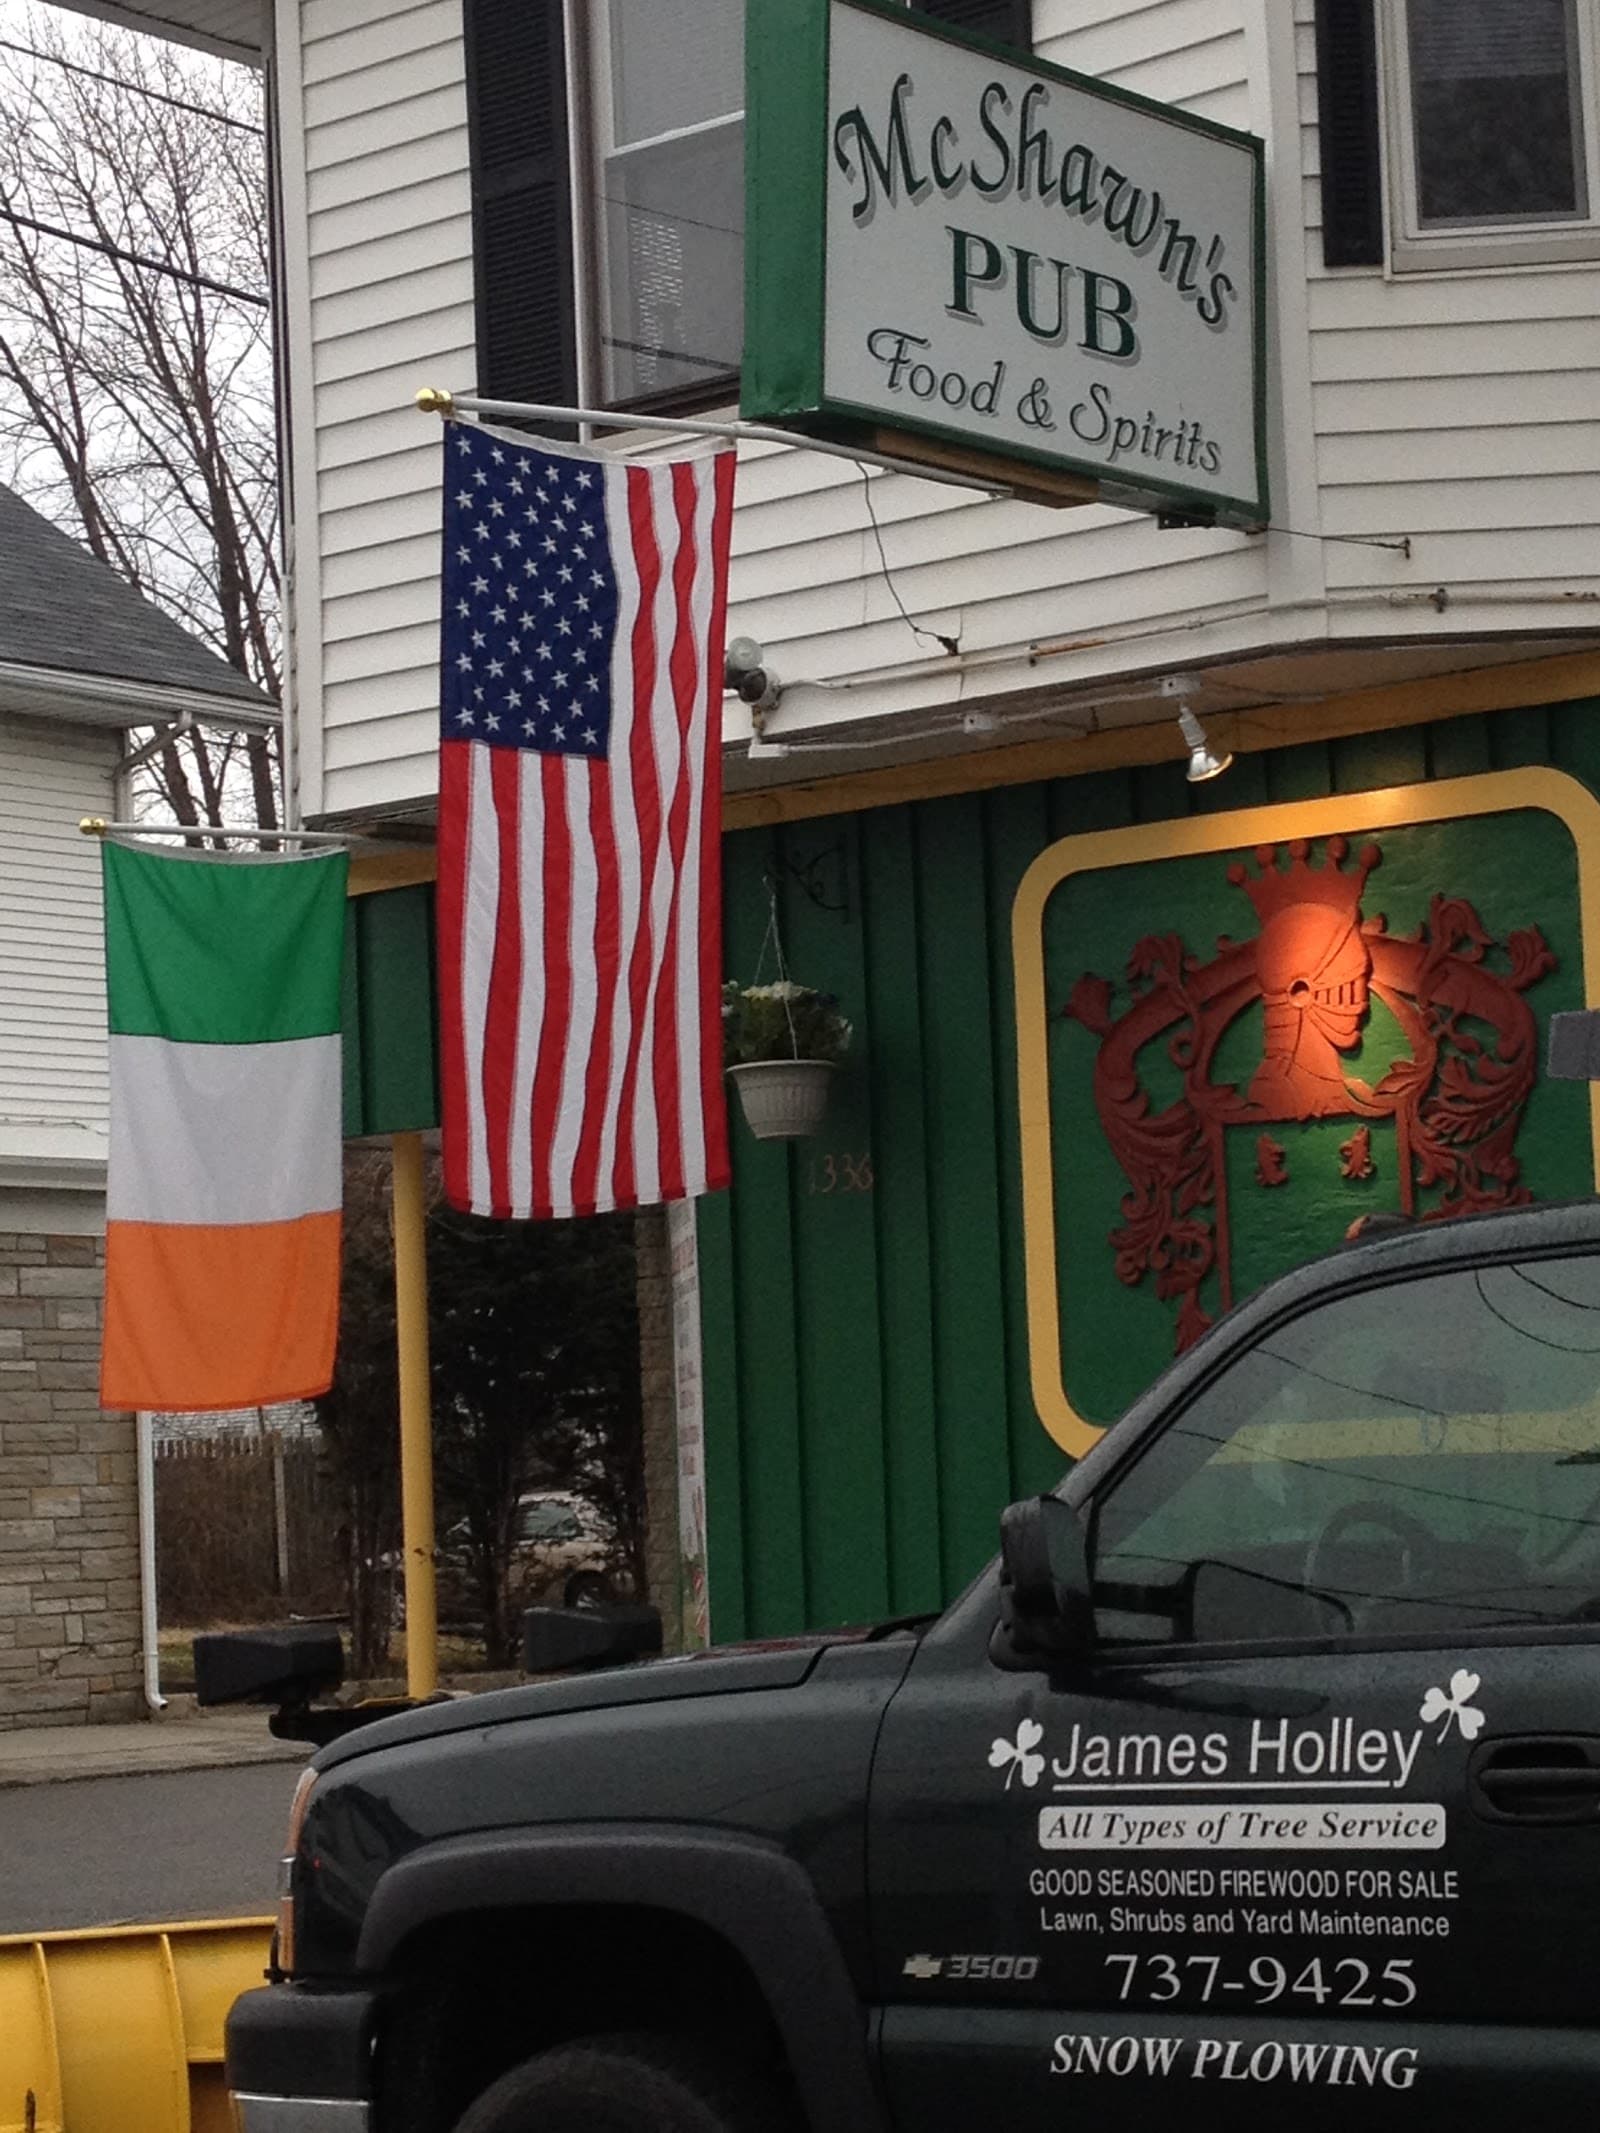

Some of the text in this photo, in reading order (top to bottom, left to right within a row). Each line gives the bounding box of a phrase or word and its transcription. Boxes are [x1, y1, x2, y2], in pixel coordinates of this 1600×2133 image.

[833, 72, 1238, 326] McShawn's
[944, 224, 1140, 365] PUB
[866, 327, 1222, 474] Food & Spirits
[1052, 1717, 1424, 1788] James Holley
[1047, 1810, 1439, 1845] All Types of Tree Service
[1029, 1868, 1460, 1899] GOOD SEASONED FIREWOOD FOR SALE
[1040, 1906, 1451, 1936] Lawn, Shrubs and Yard Maintenance
[946, 1954, 1041, 1980] 3500
[1104, 1953, 1419, 2007] 737-9425
[1050, 2034, 1419, 2089] SNOW PLOWING
